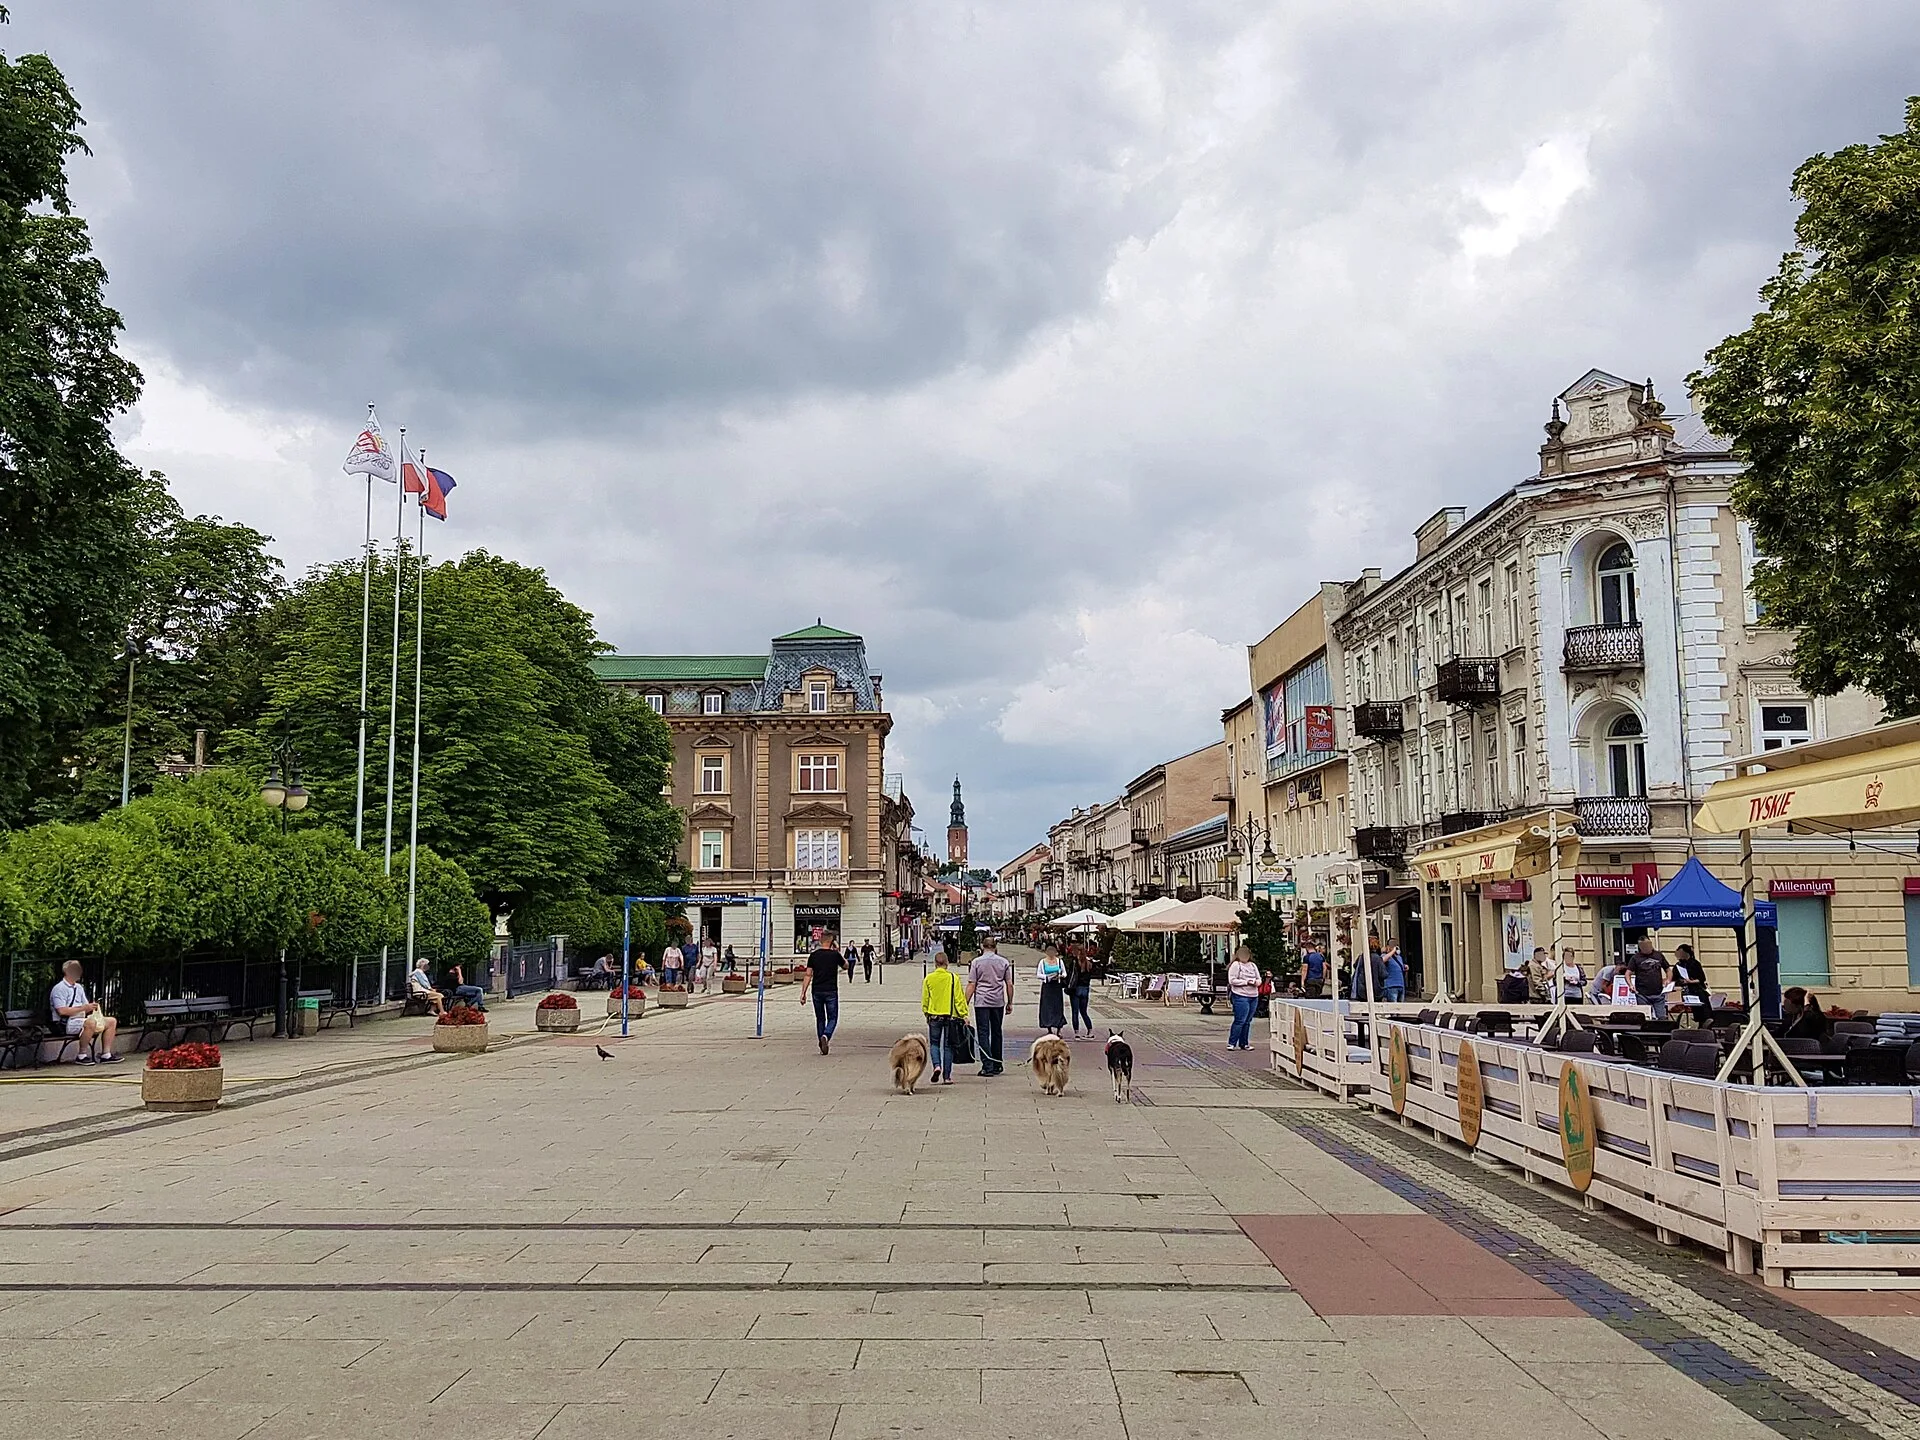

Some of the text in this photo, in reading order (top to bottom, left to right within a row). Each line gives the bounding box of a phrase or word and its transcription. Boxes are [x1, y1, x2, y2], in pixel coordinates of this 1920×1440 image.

[1748, 791, 1796, 823] TYSKIE
[1579, 875, 1635, 888] Millenniu
[1773, 881, 1832, 891] Millennium
[795, 907, 814, 915] TANIA
